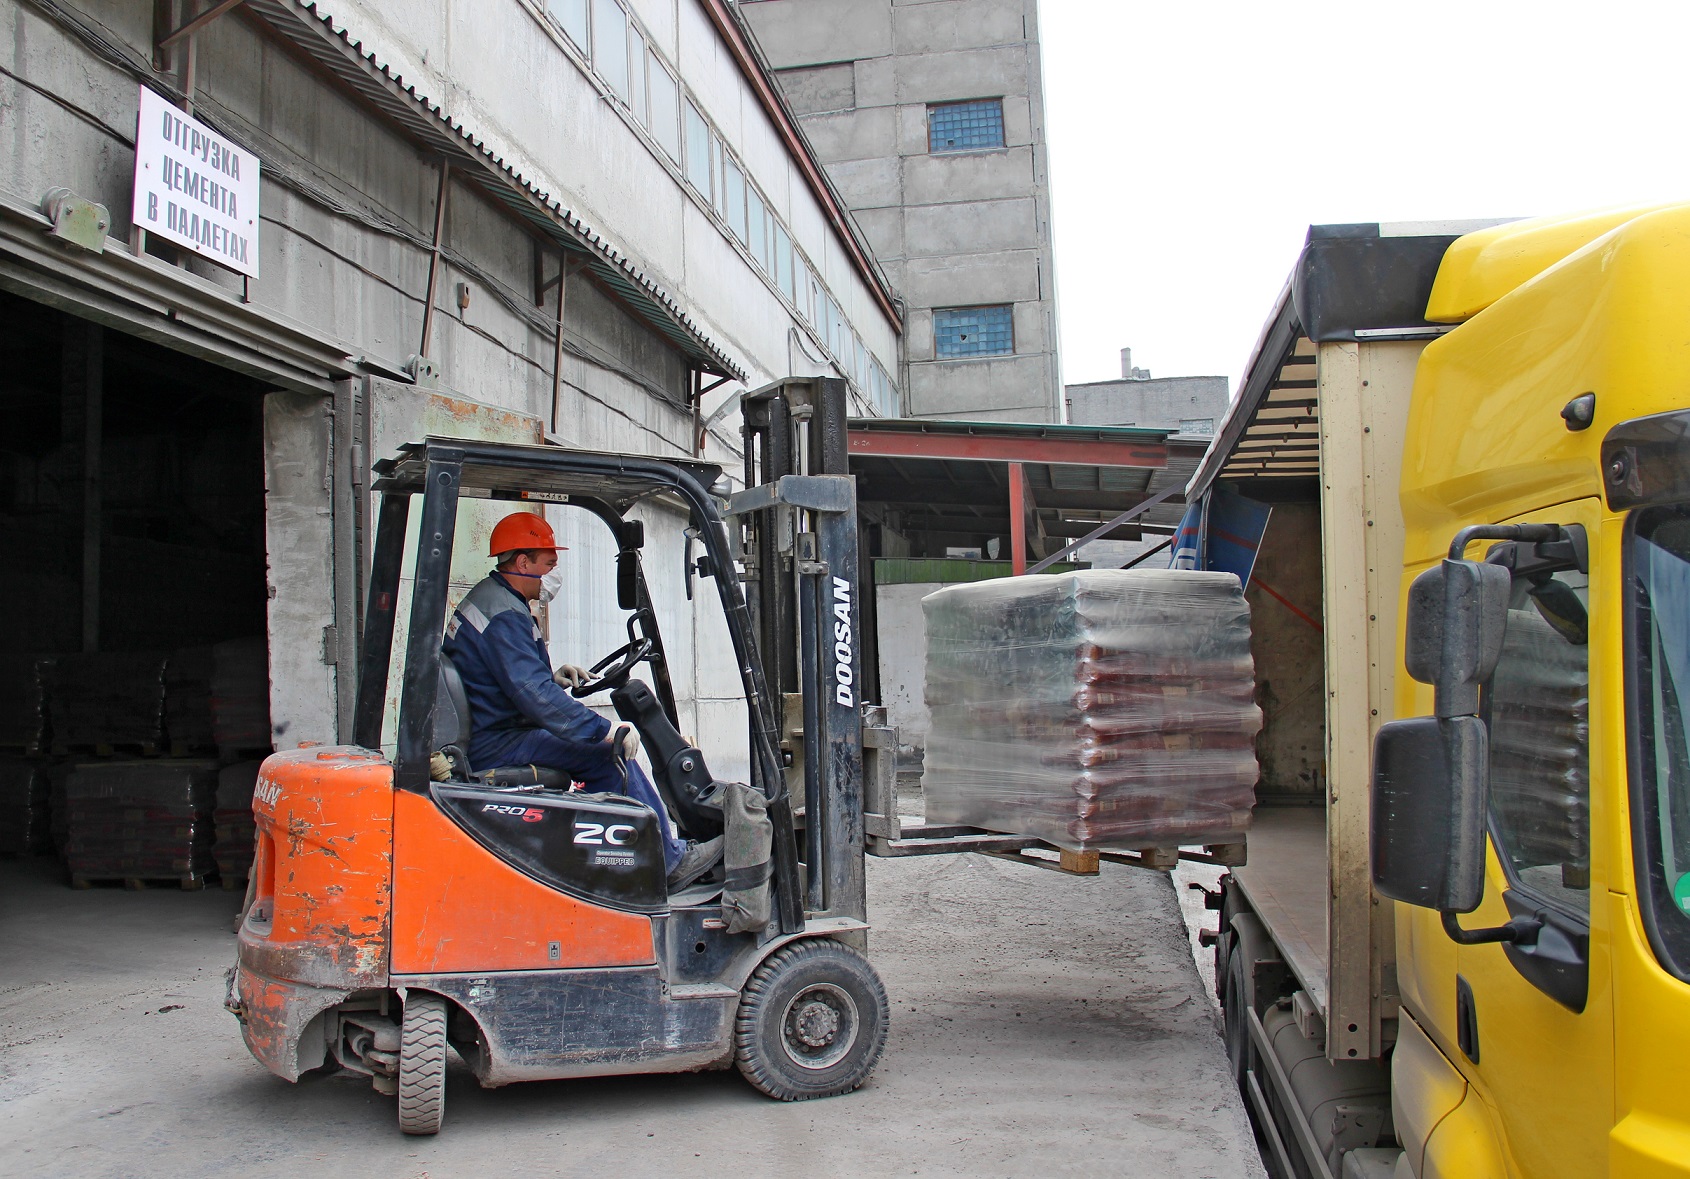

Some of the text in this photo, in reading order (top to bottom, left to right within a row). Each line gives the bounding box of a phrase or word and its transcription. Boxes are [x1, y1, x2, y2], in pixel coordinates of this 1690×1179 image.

[162, 110, 241, 182] ОТГРУЗКА
[162, 154, 238, 221] ЦЕМЕНТА
[147, 190, 249, 265] В ПАЛЛЕТАХ
[833, 576, 853, 708] DOOSAN
[595, 856, 635, 866] EQUIPPED
